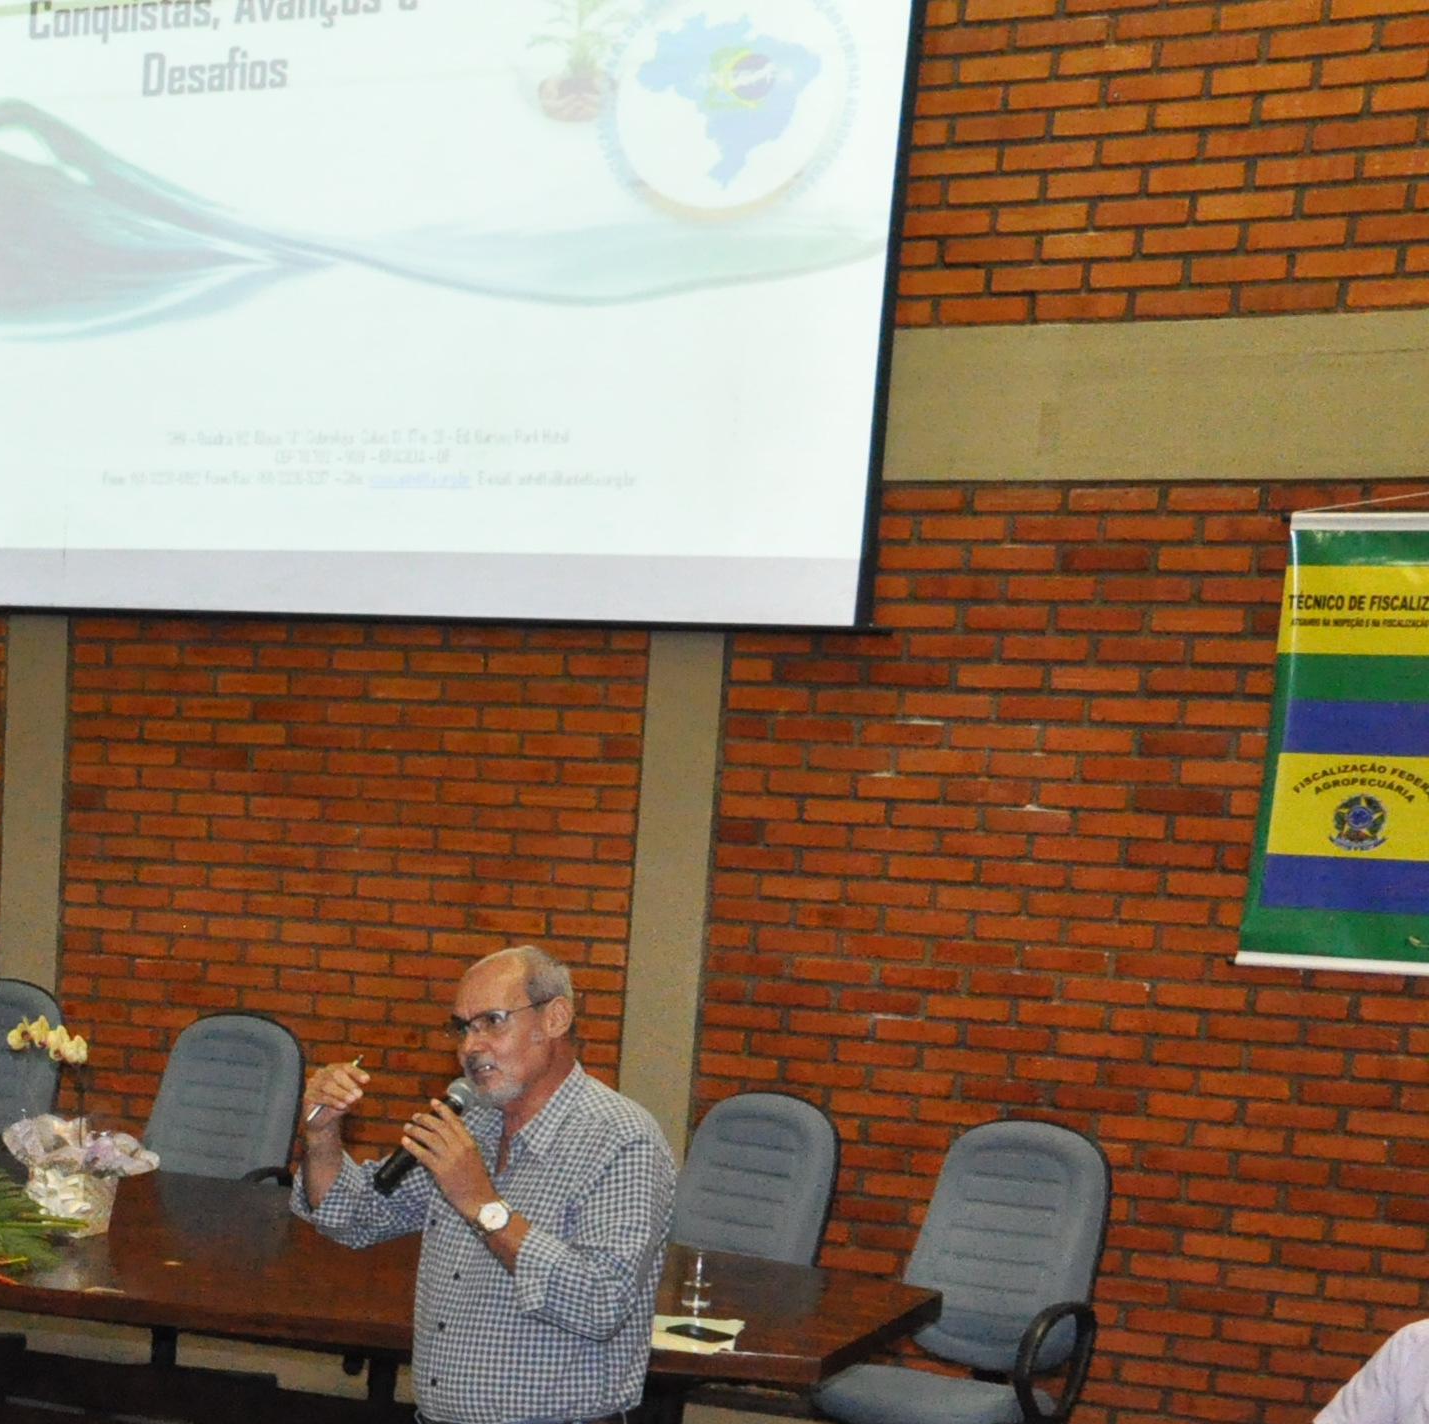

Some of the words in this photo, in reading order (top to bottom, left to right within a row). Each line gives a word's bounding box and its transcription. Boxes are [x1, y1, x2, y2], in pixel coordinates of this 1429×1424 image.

[29, 0, 220, 44] Conquistas,
[142, 46, 288, 97] Desafios
[1288, 590, 1345, 611] TÉCNICO
[1348, 595, 1366, 611] DE
[1293, 763, 1387, 793] FISCALIZAÇÃO
[1314, 777, 1415, 803] AGROPECUÁRIA
